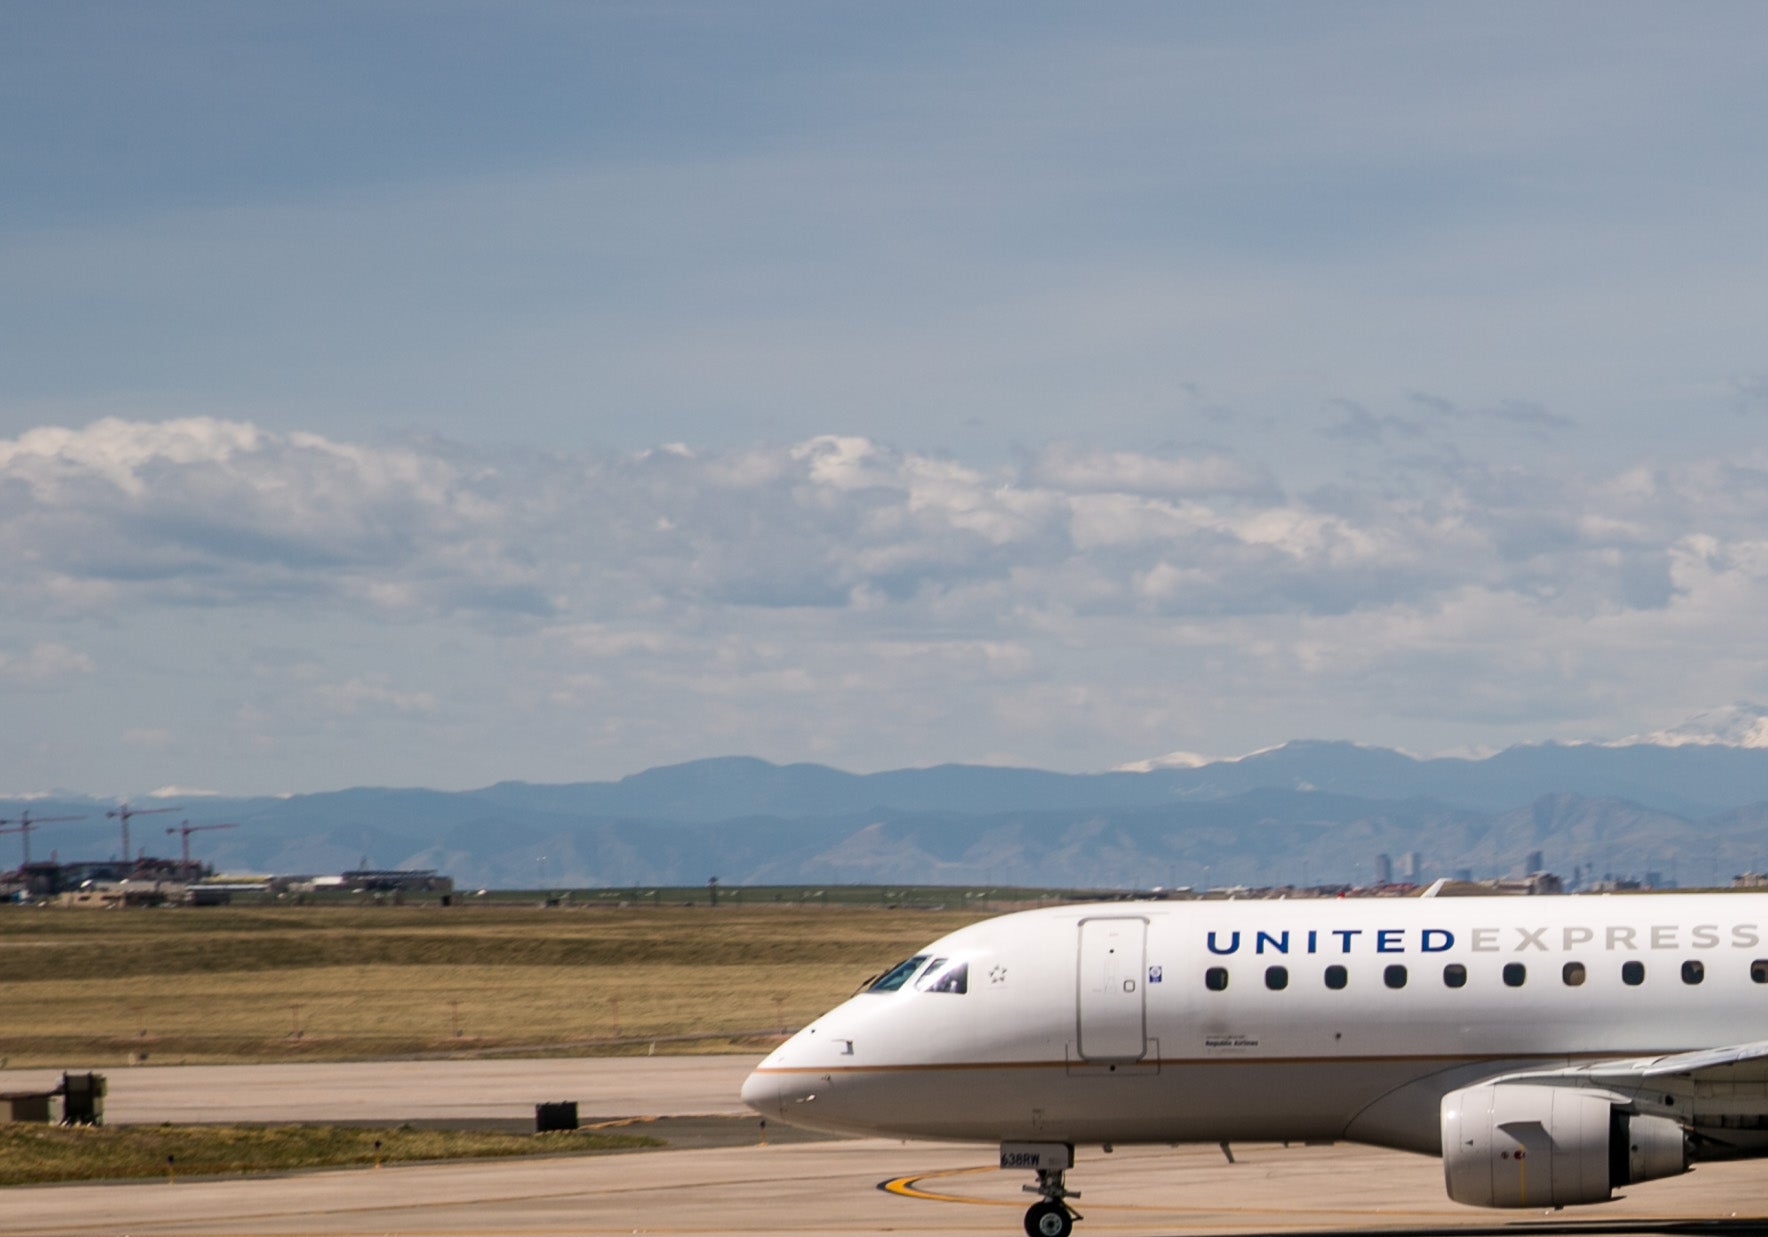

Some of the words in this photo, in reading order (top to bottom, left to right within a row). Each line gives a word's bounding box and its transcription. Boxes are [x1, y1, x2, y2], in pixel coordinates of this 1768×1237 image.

[1206, 928, 1455, 955] UNITED
[1471, 923, 1760, 952] EXPRESS
[1001, 1152, 1040, 1167] 638RW
